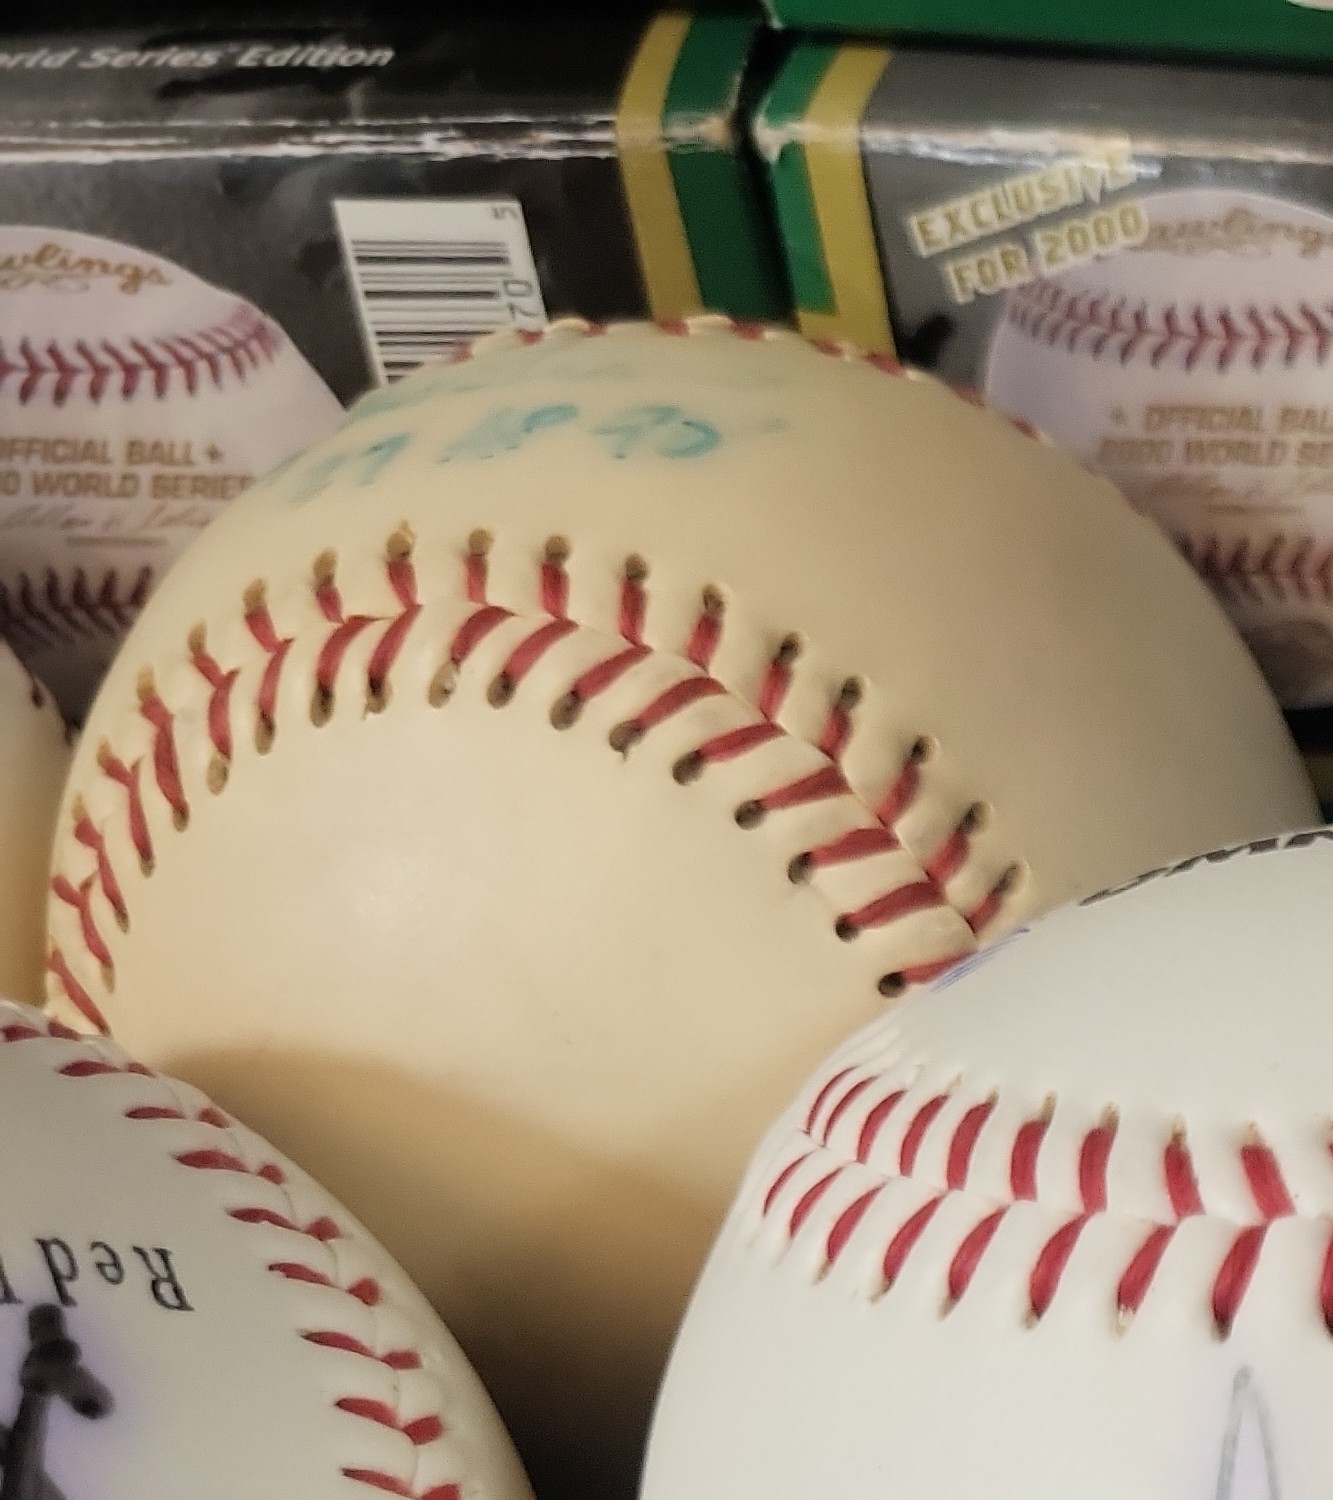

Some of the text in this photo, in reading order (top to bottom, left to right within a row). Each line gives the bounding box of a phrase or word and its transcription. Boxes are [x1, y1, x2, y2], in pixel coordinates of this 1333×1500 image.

[78, 46, 217, 69] Series
[236, 44, 396, 68] Edition
[908, 140, 1138, 256] EXCLUSIVE
[1033, 201, 1148, 275] 2000
[947, 243, 1032, 302] FOR
[1143, 404, 1264, 433] OFFICIAL
[125, 438, 196, 466] BALL
[1182, 438, 1290, 468] WORLD
[32, 470, 140, 499] WORLD
[34, 1237, 195, 1312] Red
